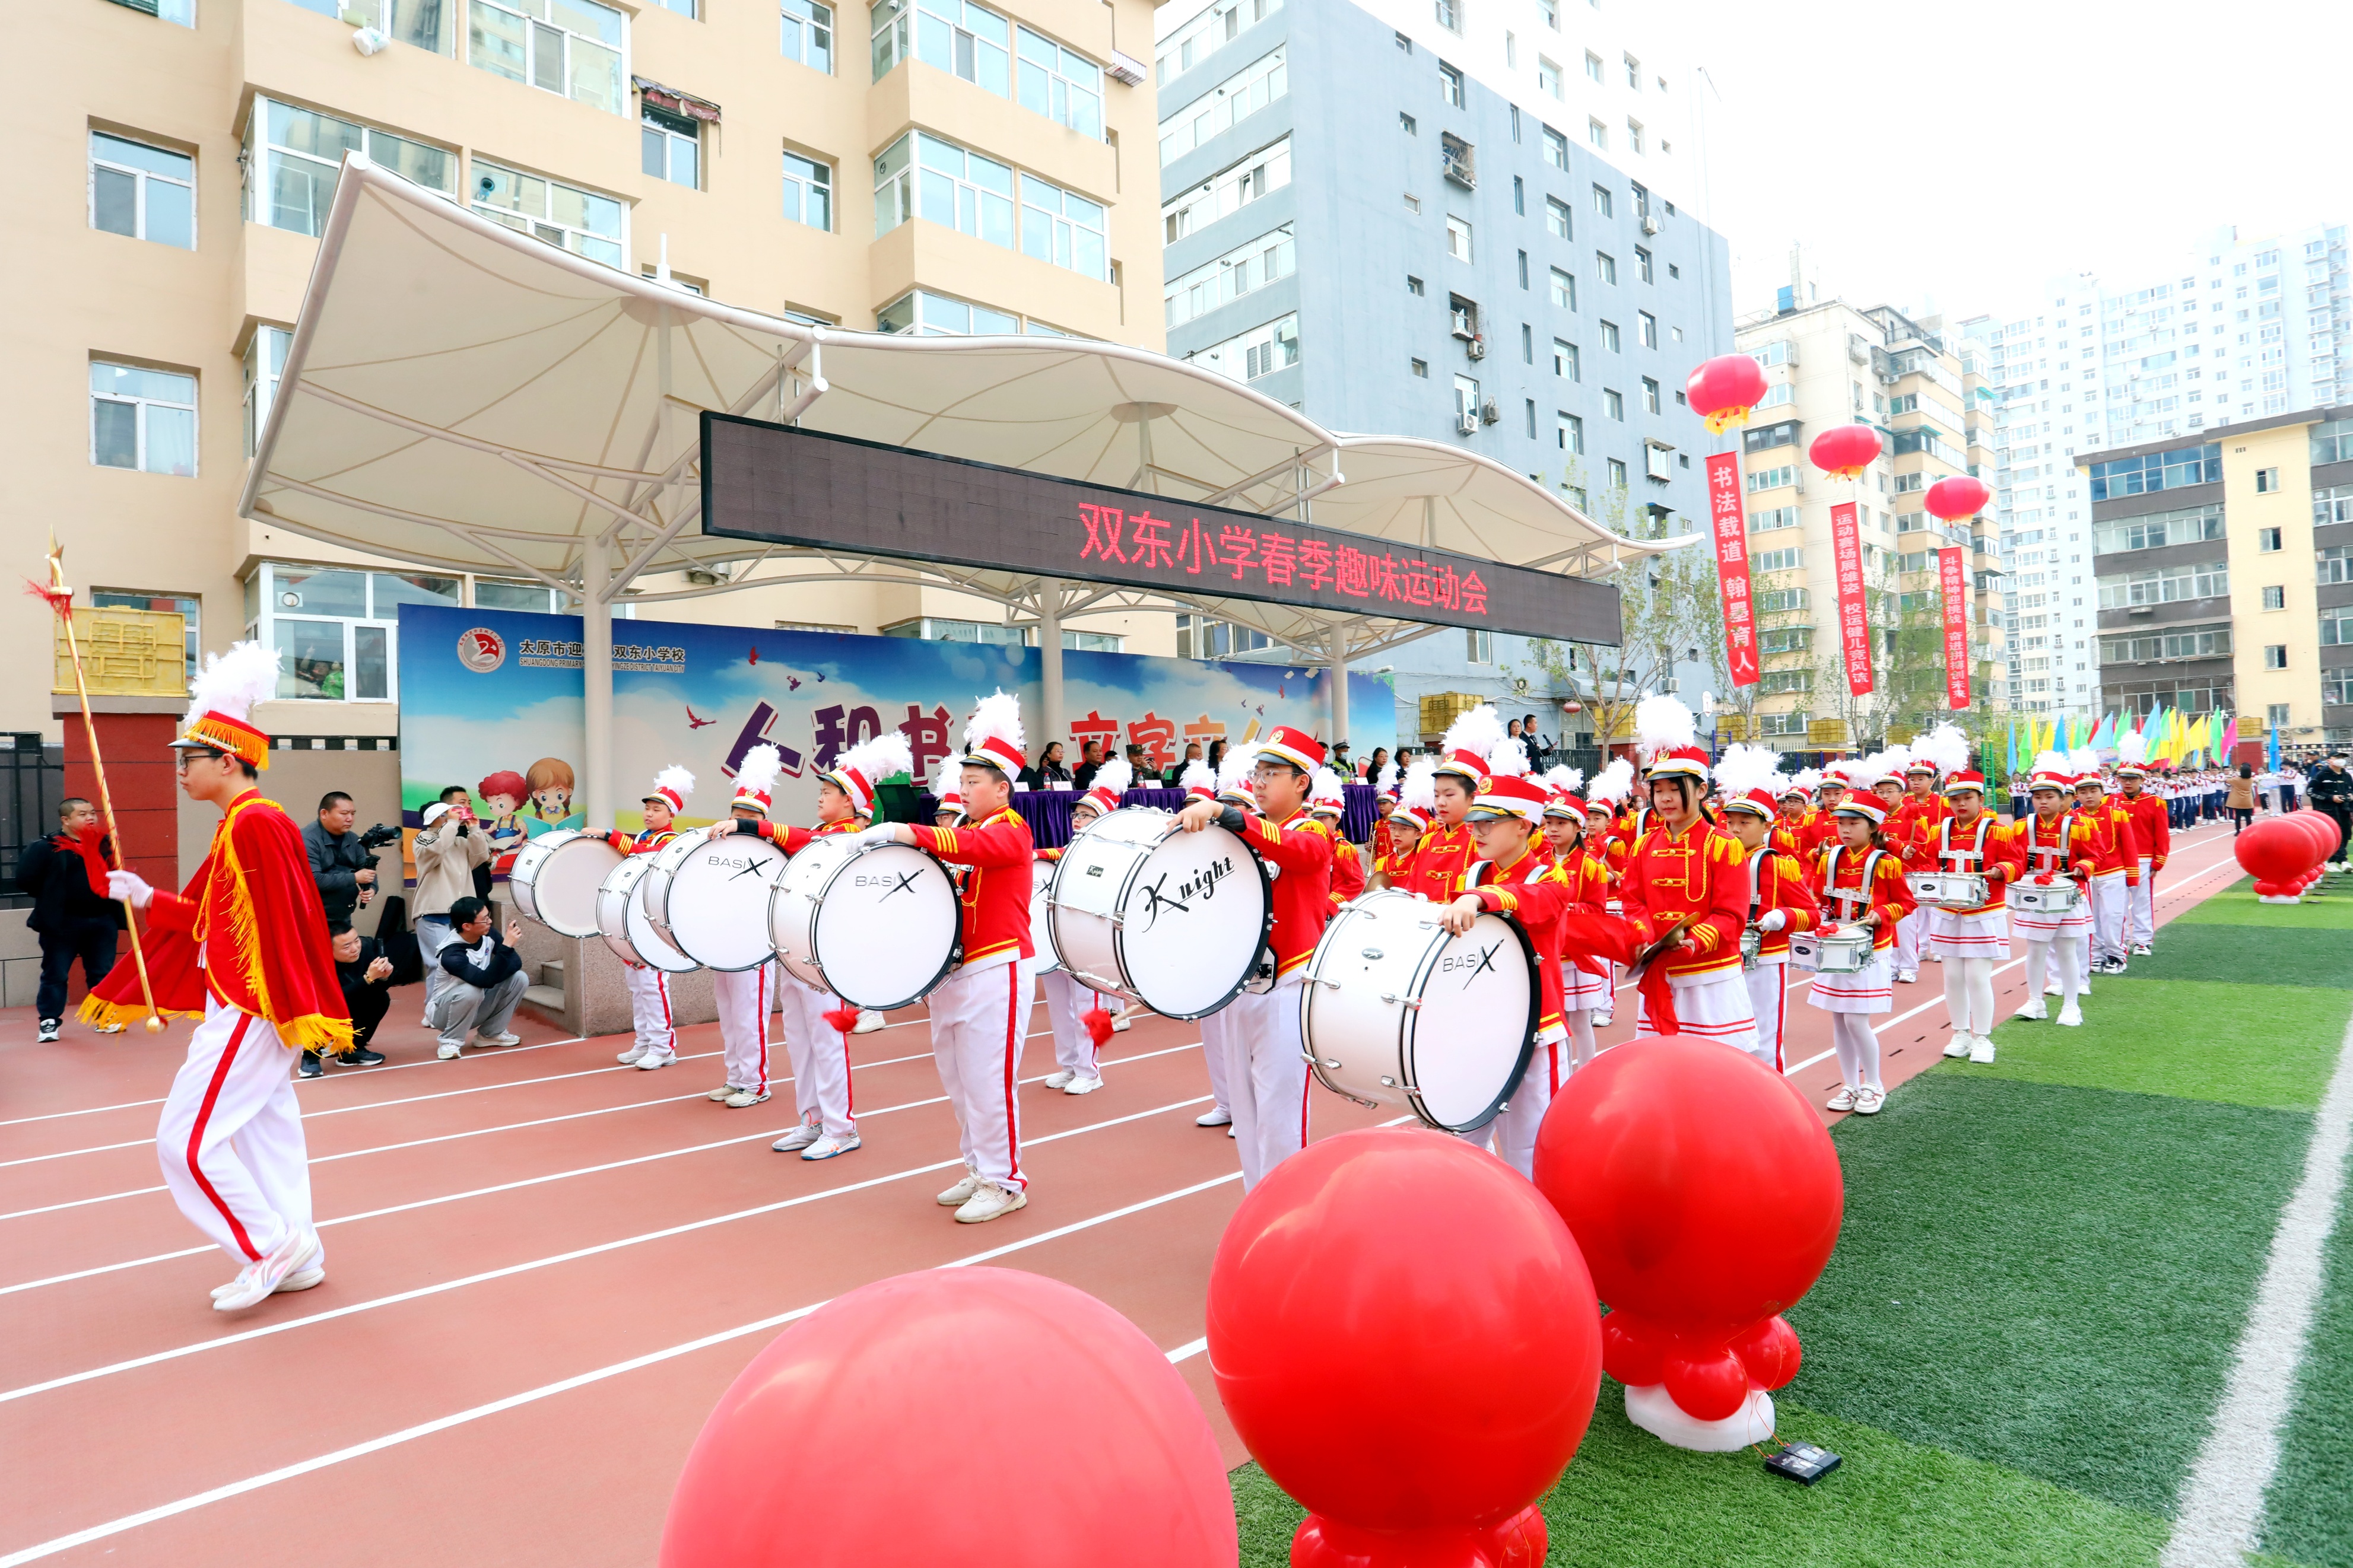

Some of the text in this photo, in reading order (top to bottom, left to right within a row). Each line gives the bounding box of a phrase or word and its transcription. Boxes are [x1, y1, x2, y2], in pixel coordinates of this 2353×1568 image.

[1078, 502, 1488, 615] 双东小学春季趣味运动会
[1713, 466, 1755, 672] 书法载道 翰墨育人
[1836, 514, 1869, 683] 运动赛场展雄姿 校运健儿竞风流
[1943, 556, 1967, 698] 斗争精神迎挑战 奋进拼搏创未来
[520, 657, 558, 667] SHUANGDONG
[559, 659, 582, 668] PRIMARY
[612, 662, 630, 670] YINGZE
[630, 663, 652, 671] DISTRICT
[652, 664, 674, 672] TAIYUAN
[708, 856, 773, 881] BASIX
[855, 869, 925, 903] BASIX
[1136, 857, 1235, 933] Knight
[1443, 939, 1504, 990] BASIX
